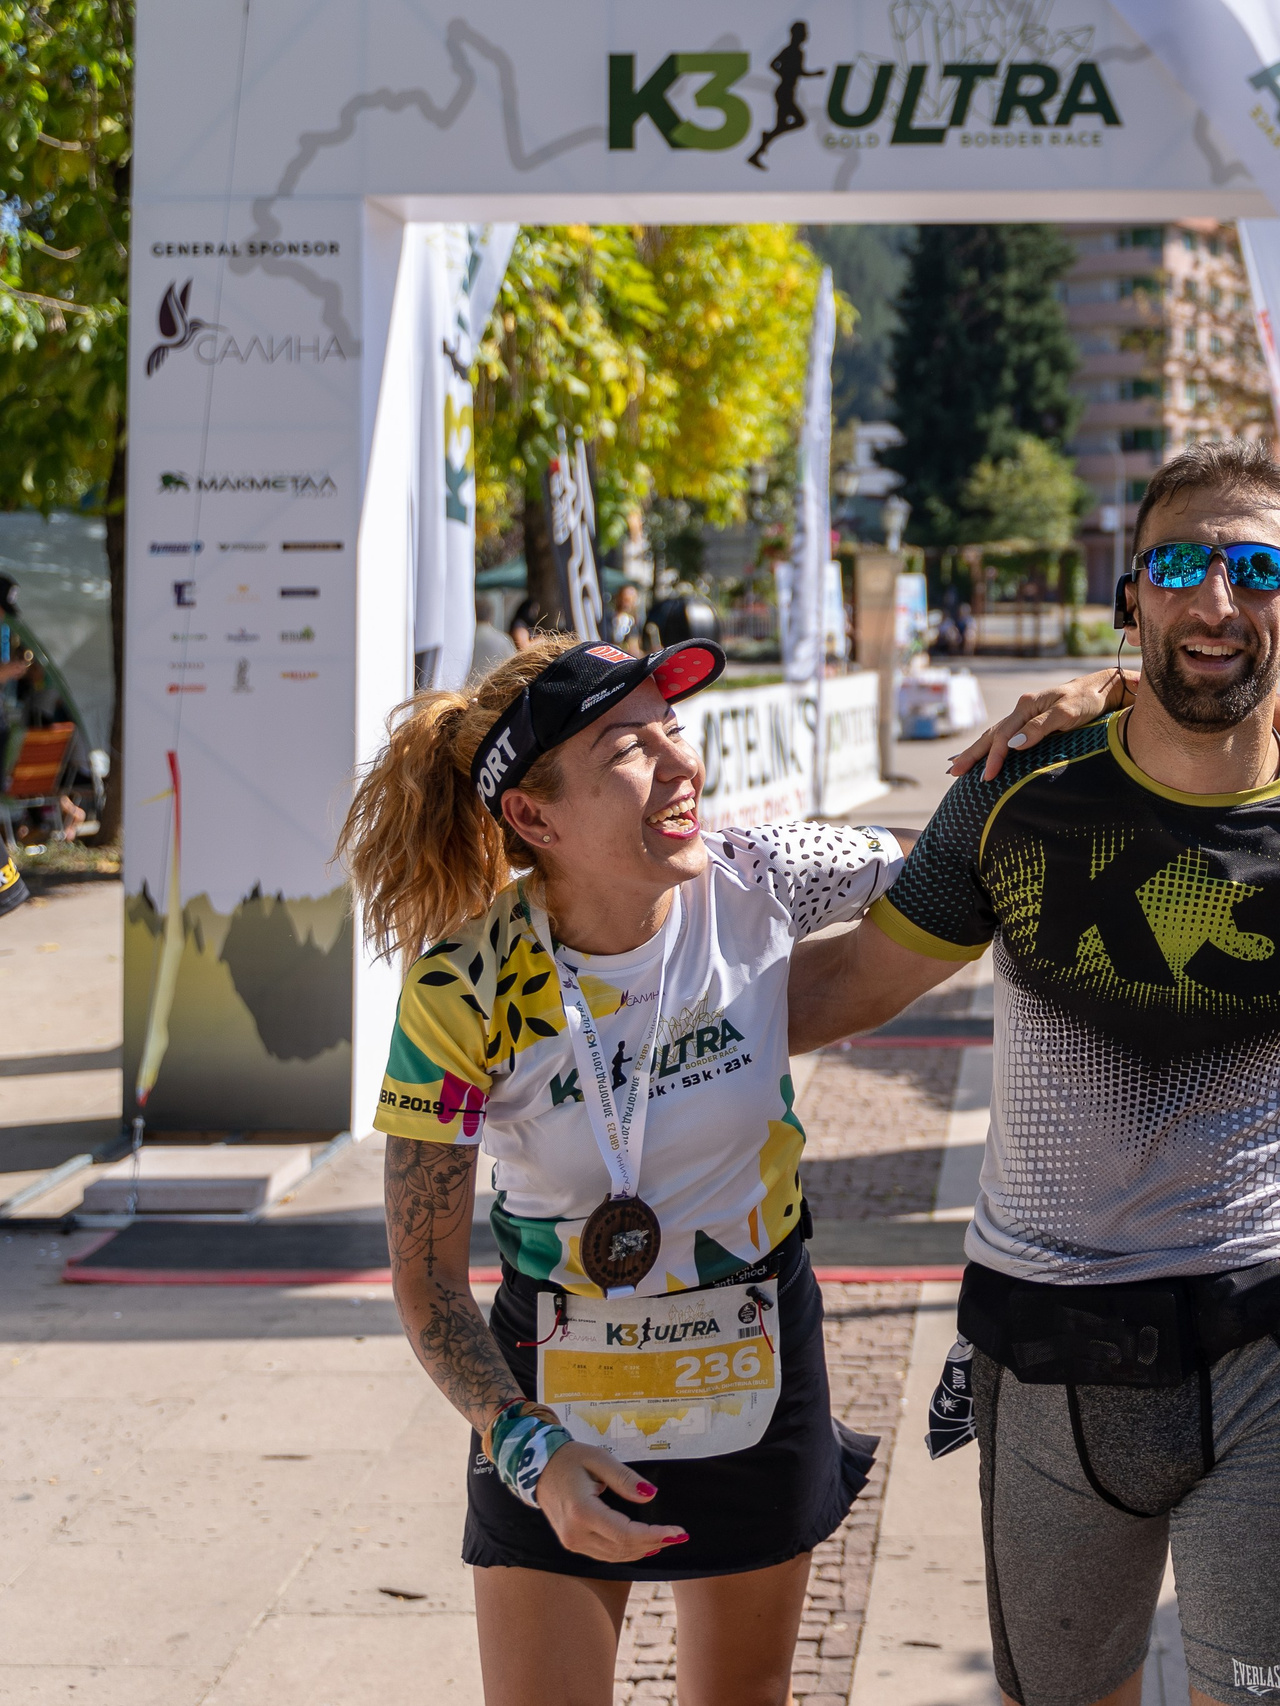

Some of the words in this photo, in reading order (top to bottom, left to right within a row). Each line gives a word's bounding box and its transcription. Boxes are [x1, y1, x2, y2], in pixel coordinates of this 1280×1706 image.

[609, 53, 751, 151] K3
[826, 62, 1123, 146] ULTRA
[823, 131, 880, 149] GOLD
[960, 131, 1043, 149] BORDER
[1048, 131, 1104, 149] RACE
[152, 240, 239, 257] GENERAL
[247, 240, 341, 257] SPONSOR
[477, 727, 517, 811] PORT
[682, 1074, 701, 1088] 53
[702, 1069, 714, 1083] k
[724, 1060, 742, 1074] 23
[742, 1052, 753, 1065] k
[684, 1053, 718, 1071] BORDER
[719, 1045, 738, 1060] RACE
[399, 1095, 445, 1115] 2019
[606, 1322, 640, 1347] K3
[654, 1317, 721, 1344] ULTRA
[675, 1345, 761, 1389] 236
